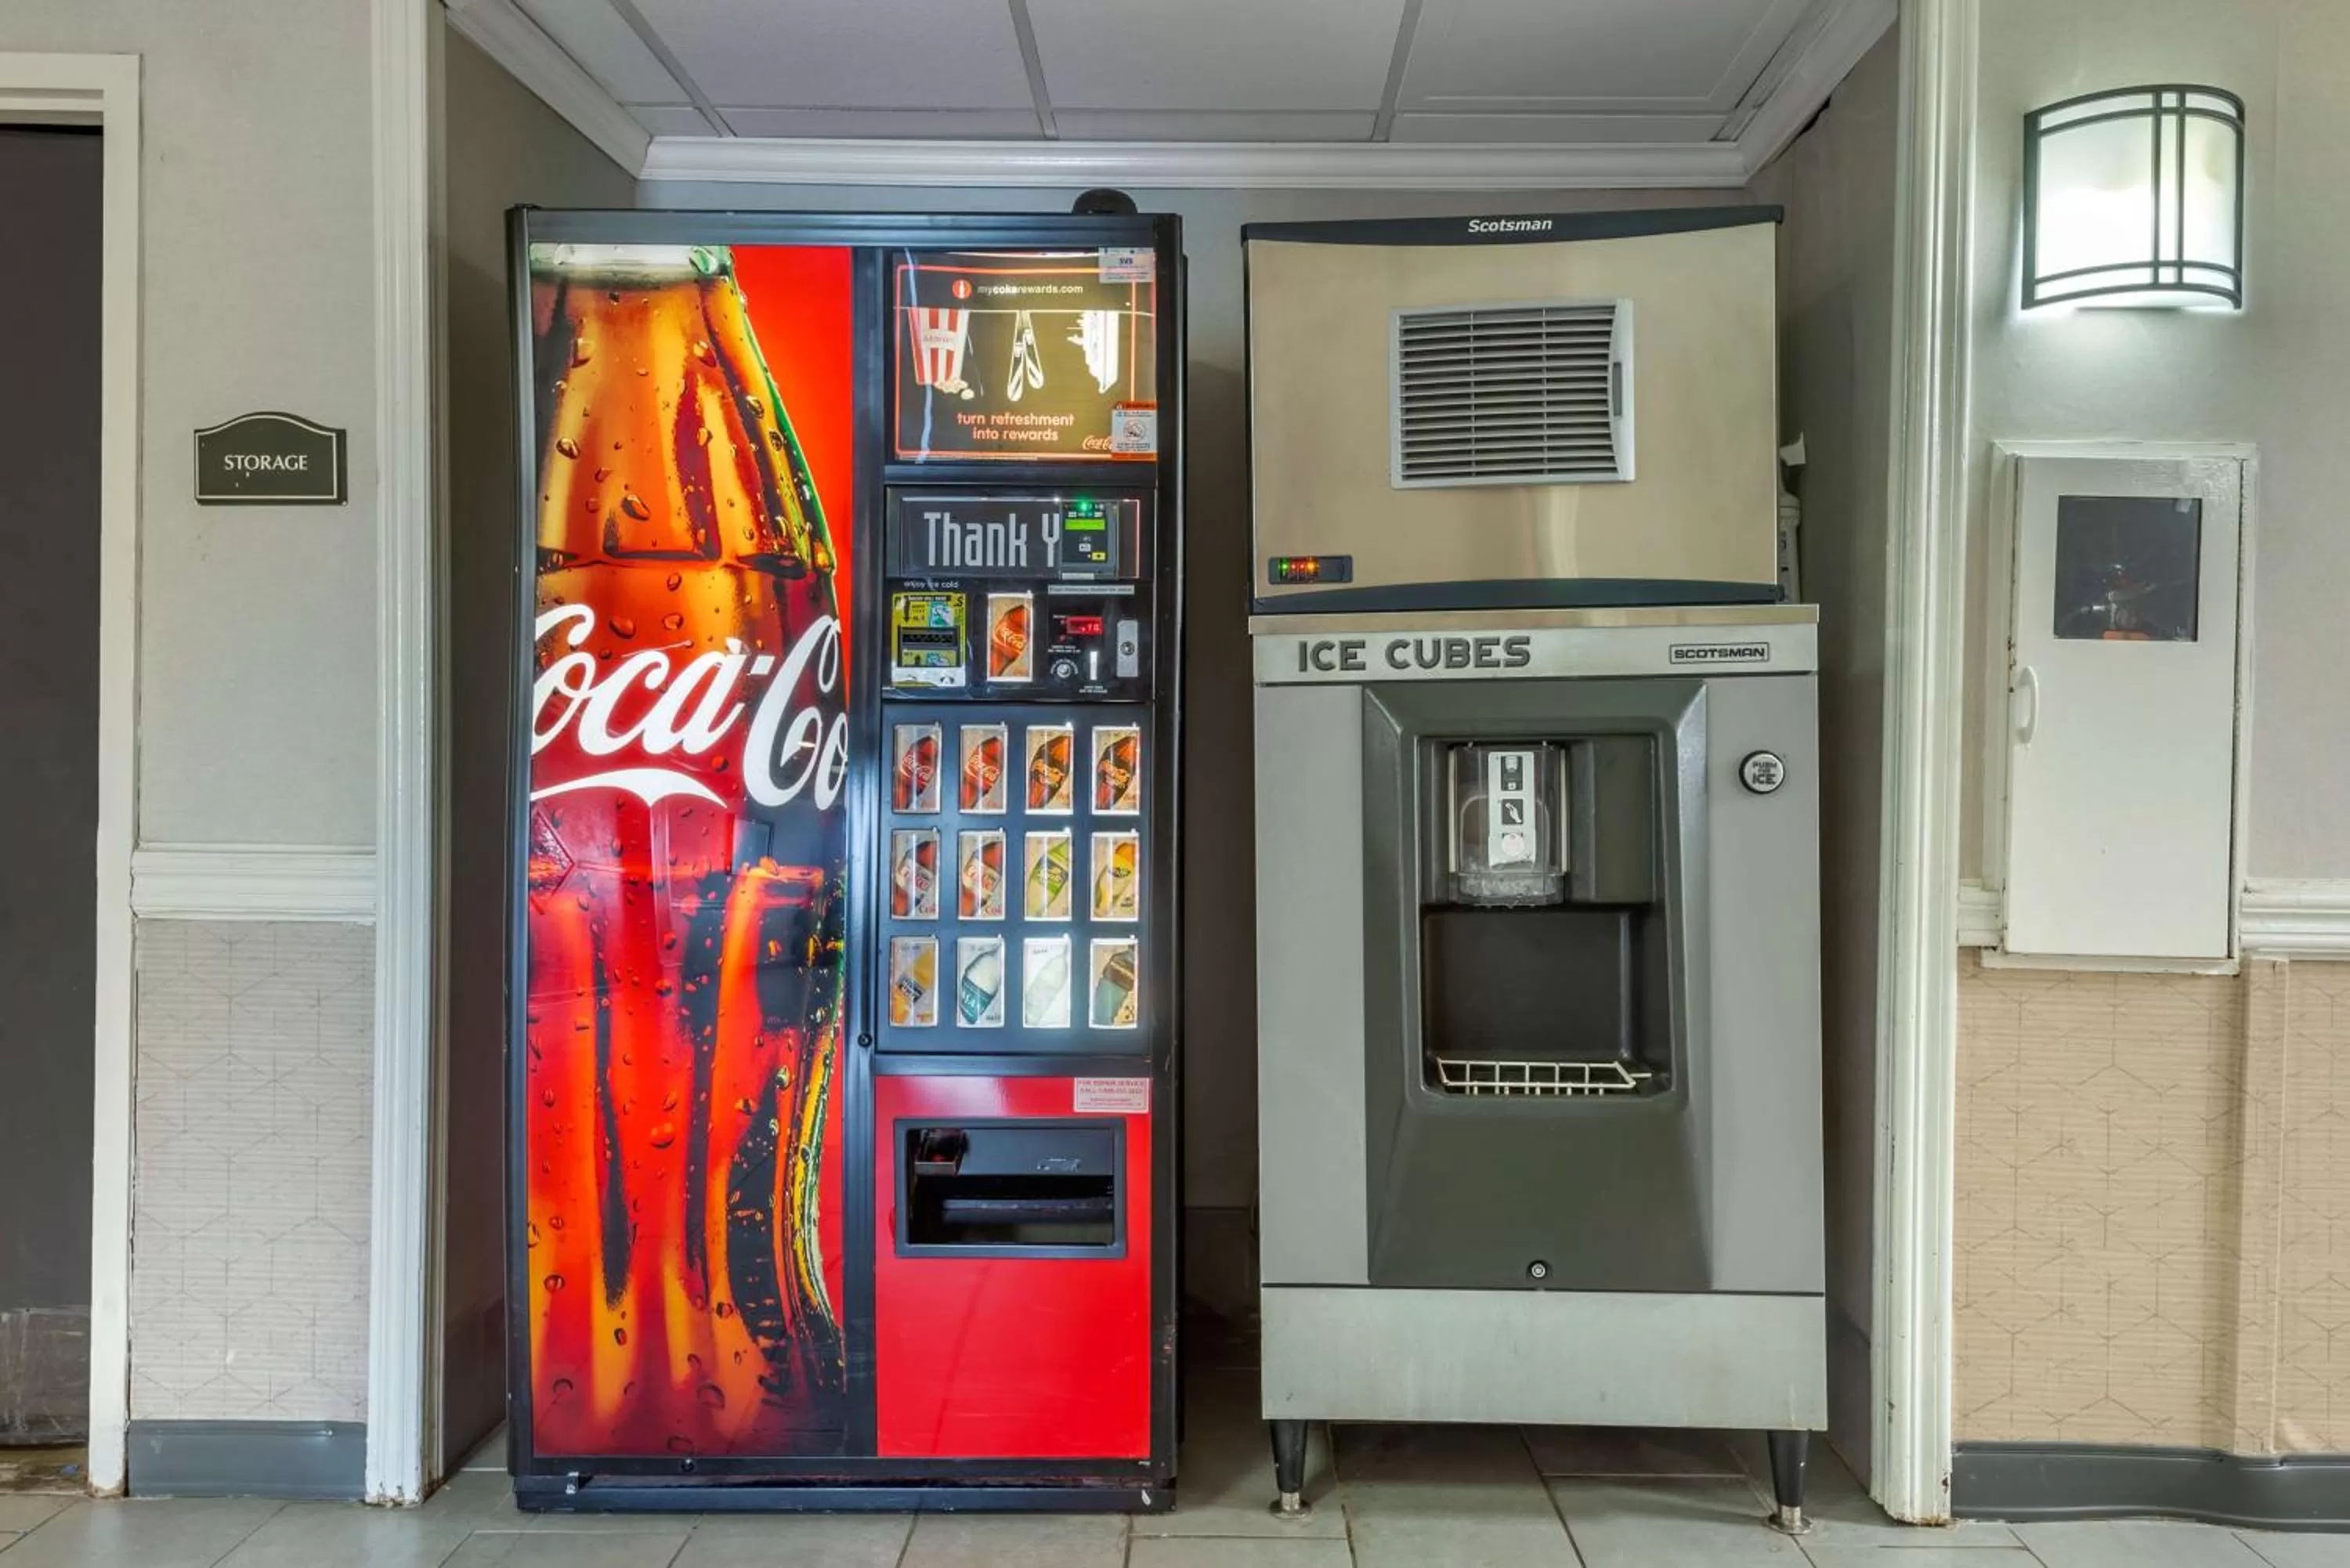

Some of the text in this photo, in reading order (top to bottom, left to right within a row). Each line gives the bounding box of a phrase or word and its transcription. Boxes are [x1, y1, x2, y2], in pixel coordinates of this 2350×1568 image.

[1468, 219, 1553, 233] Scotsman
[978, 284, 1083, 295] mycokerewards.com
[957, 412, 1076, 426] turn refreshment
[973, 427, 1058, 440] into rewards
[224, 454, 308, 471] STORAGE
[924, 511, 1028, 567] Thank
[1298, 635, 1531, 672] ICE CUBES
[1674, 648, 1766, 659] SCOTSMAN
[1752, 772, 1777, 784] ICE
